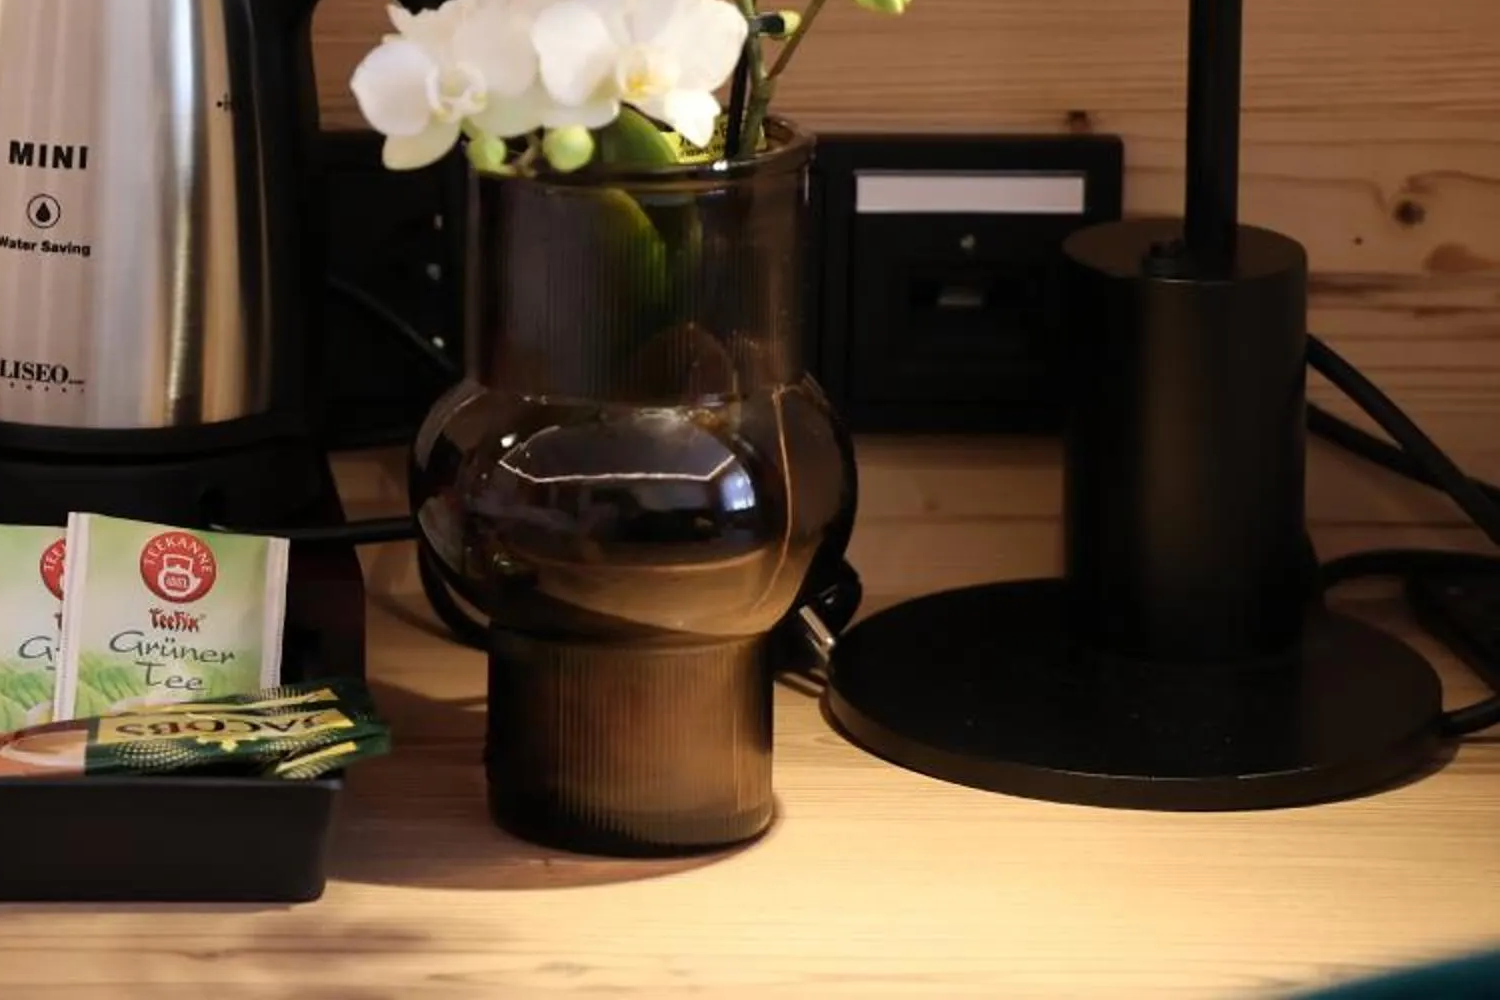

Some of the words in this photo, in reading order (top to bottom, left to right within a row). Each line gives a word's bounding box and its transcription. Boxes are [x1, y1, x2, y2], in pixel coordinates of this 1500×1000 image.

[9, 140, 88, 169] MINI
[41, 240, 91, 257] Saving
[144, 537, 213, 573] TEEKANNE
[109, 630, 235, 664] Grüner
[135, 660, 207, 691] Tee
